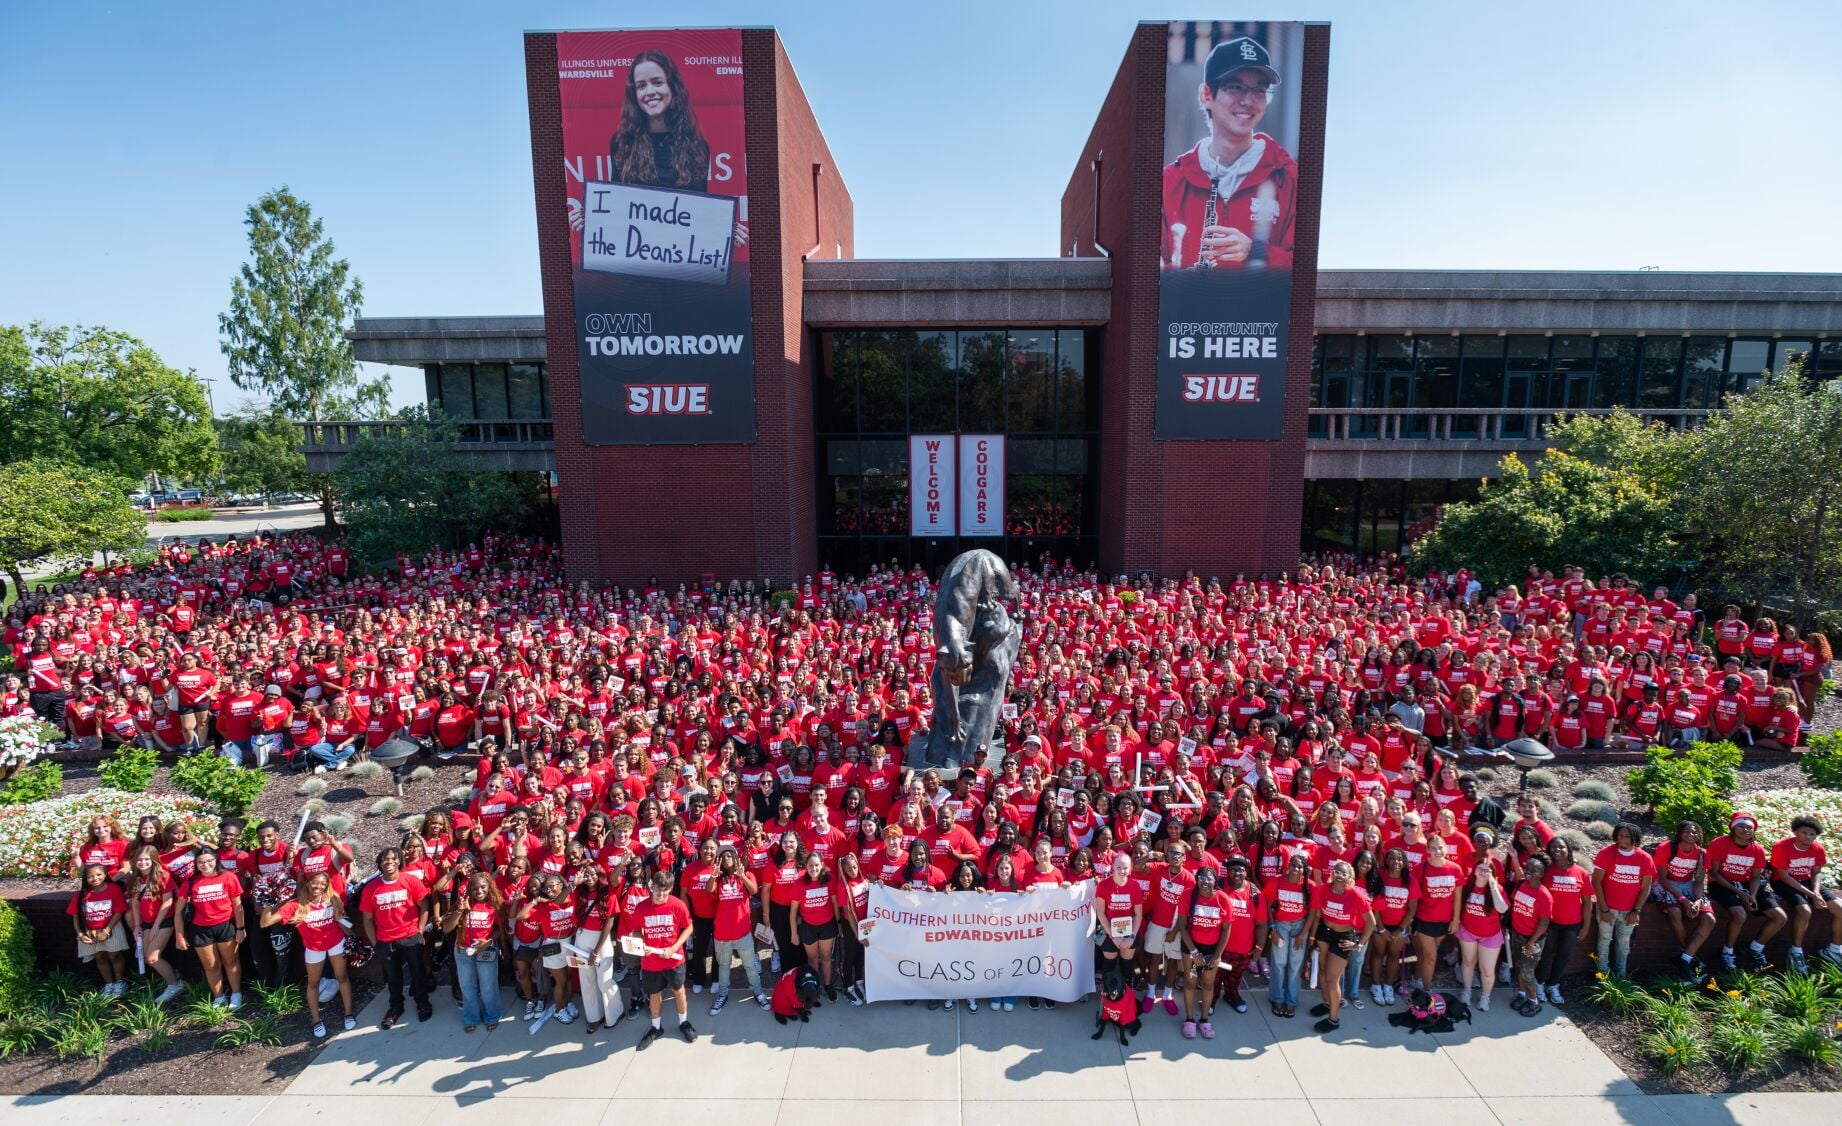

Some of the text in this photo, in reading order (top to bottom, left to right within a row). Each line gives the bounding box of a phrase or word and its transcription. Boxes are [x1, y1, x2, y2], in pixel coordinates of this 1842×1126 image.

[562, 60, 595, 68] ILLINOIS
[684, 56, 729, 65] SOUTHERN
[716, 67, 743, 75] EDWA
[559, 70, 614, 78] WARDSVILLE
[592, 190, 611, 213] I
[629, 196, 691, 227] made
[588, 224, 731, 273] the Dean's List!
[585, 313, 652, 334] OWN
[1168, 322, 1278, 336] OPPORTUNITY
[585, 334, 744, 356] TOMORROW
[1169, 337, 1278, 359] IS HERE
[925, 440, 941, 524] WELCOME
[976, 440, 988, 525] COUGARS
[873, 901, 1092, 928] SOUTHERN ILLINOIS UNIVERSITY
[924, 926, 1045, 943] EDWARDSVILLE
[897, 955, 1073, 982] CLASS OF 2030
